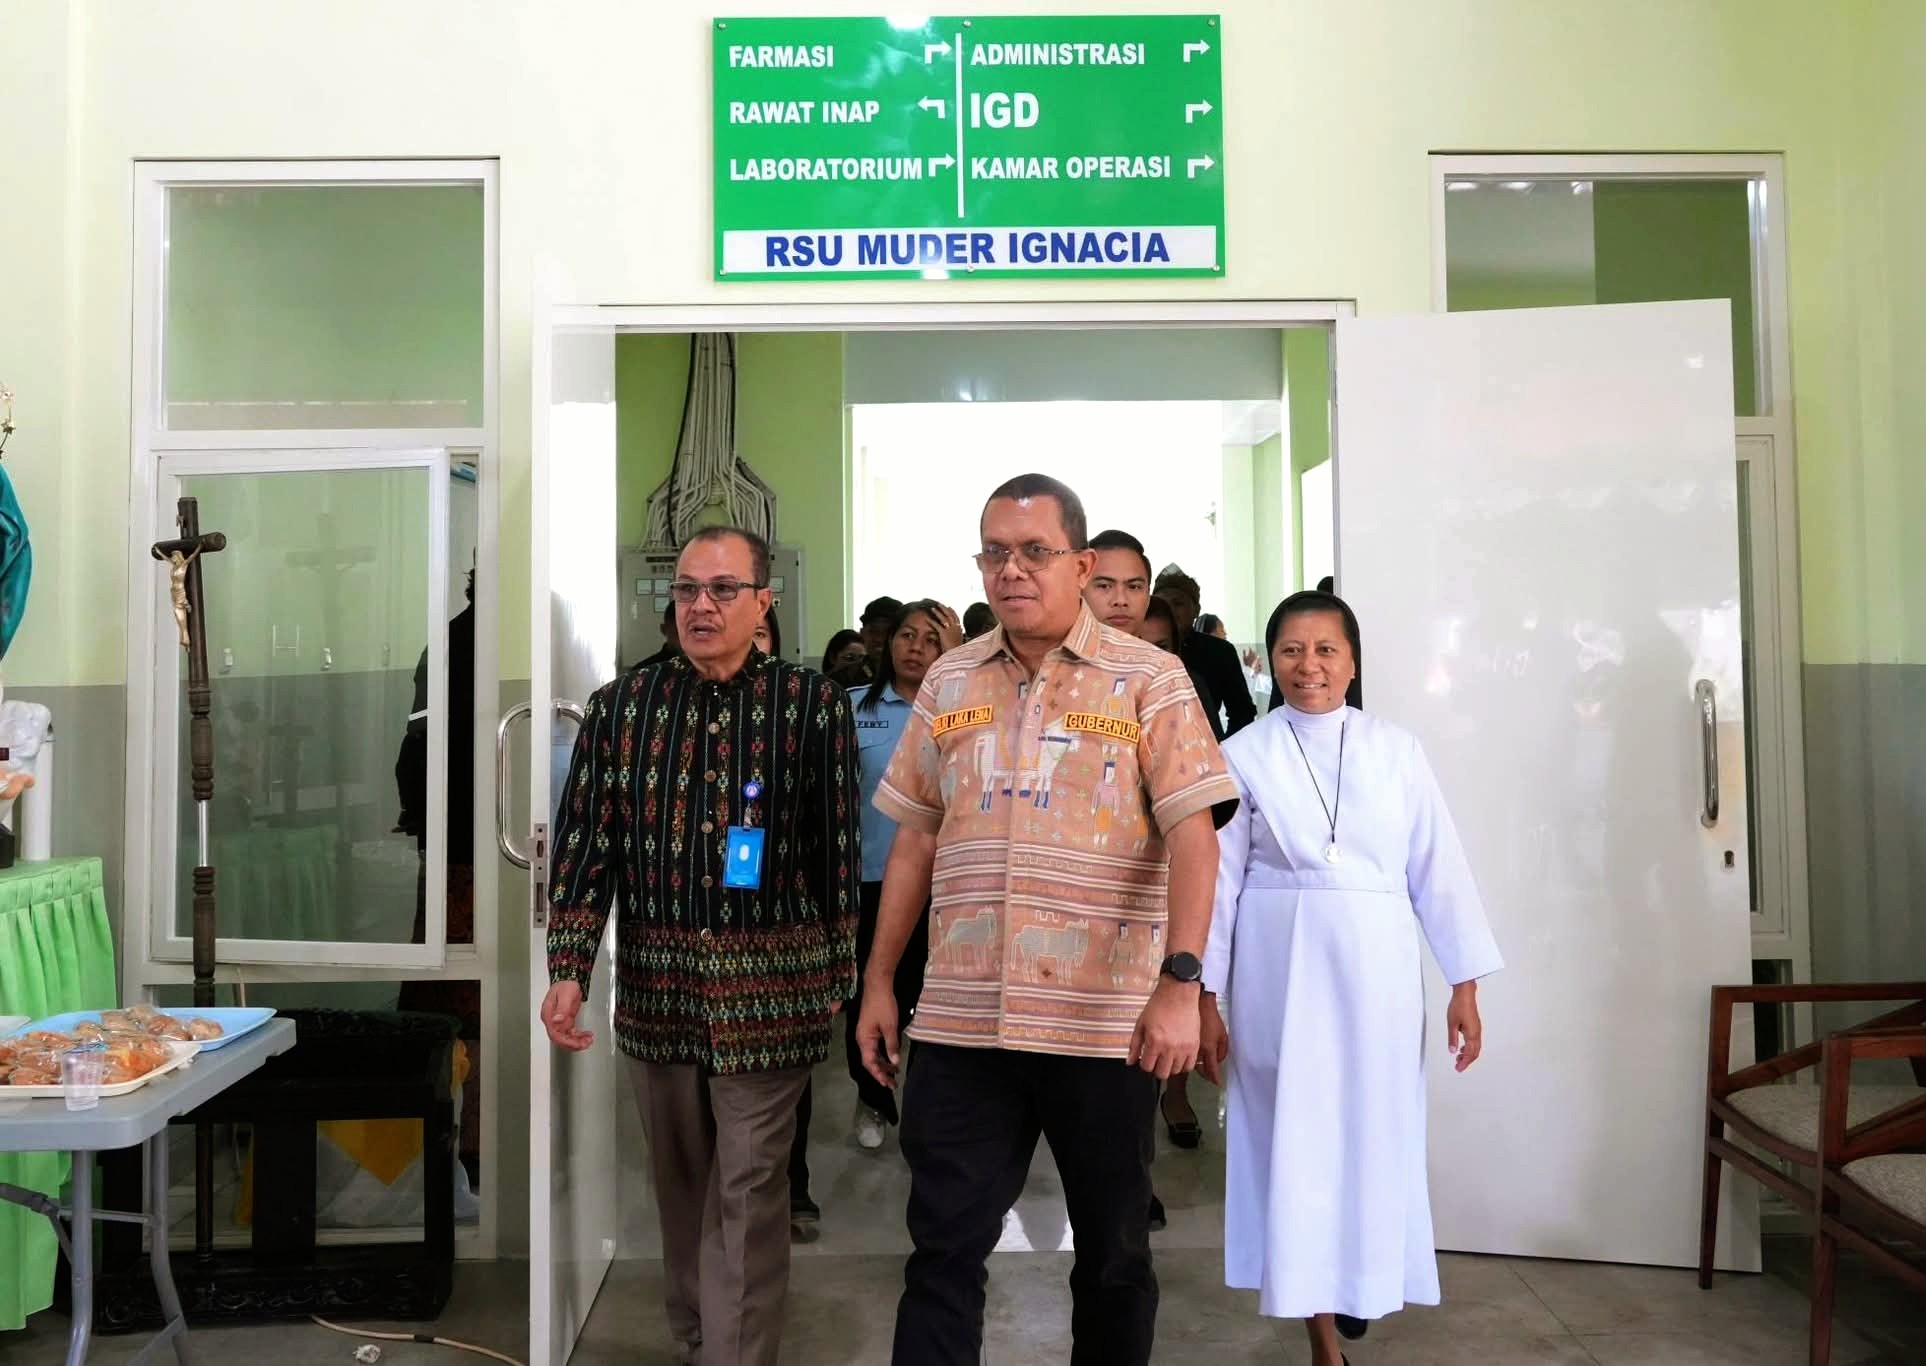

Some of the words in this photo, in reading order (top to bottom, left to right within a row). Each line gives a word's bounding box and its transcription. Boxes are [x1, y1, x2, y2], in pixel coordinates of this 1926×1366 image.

[729, 45, 834, 68] FARMASI
[971, 43, 1145, 66] ADMINISTRASI
[730, 101, 815, 124] RAWAT
[822, 100, 880, 123] INAP
[970, 92, 1040, 129] IGD
[730, 157, 922, 181] LABORATORIUM
[971, 156, 1059, 179] KAMAR
[1066, 156, 1171, 179] OPERASI
[766, 235, 843, 267] RSU
[858, 233, 995, 266] MUDER
[1009, 231, 1170, 264] IGNACIA
[1068, 715, 1138, 740] GUBERNUR
